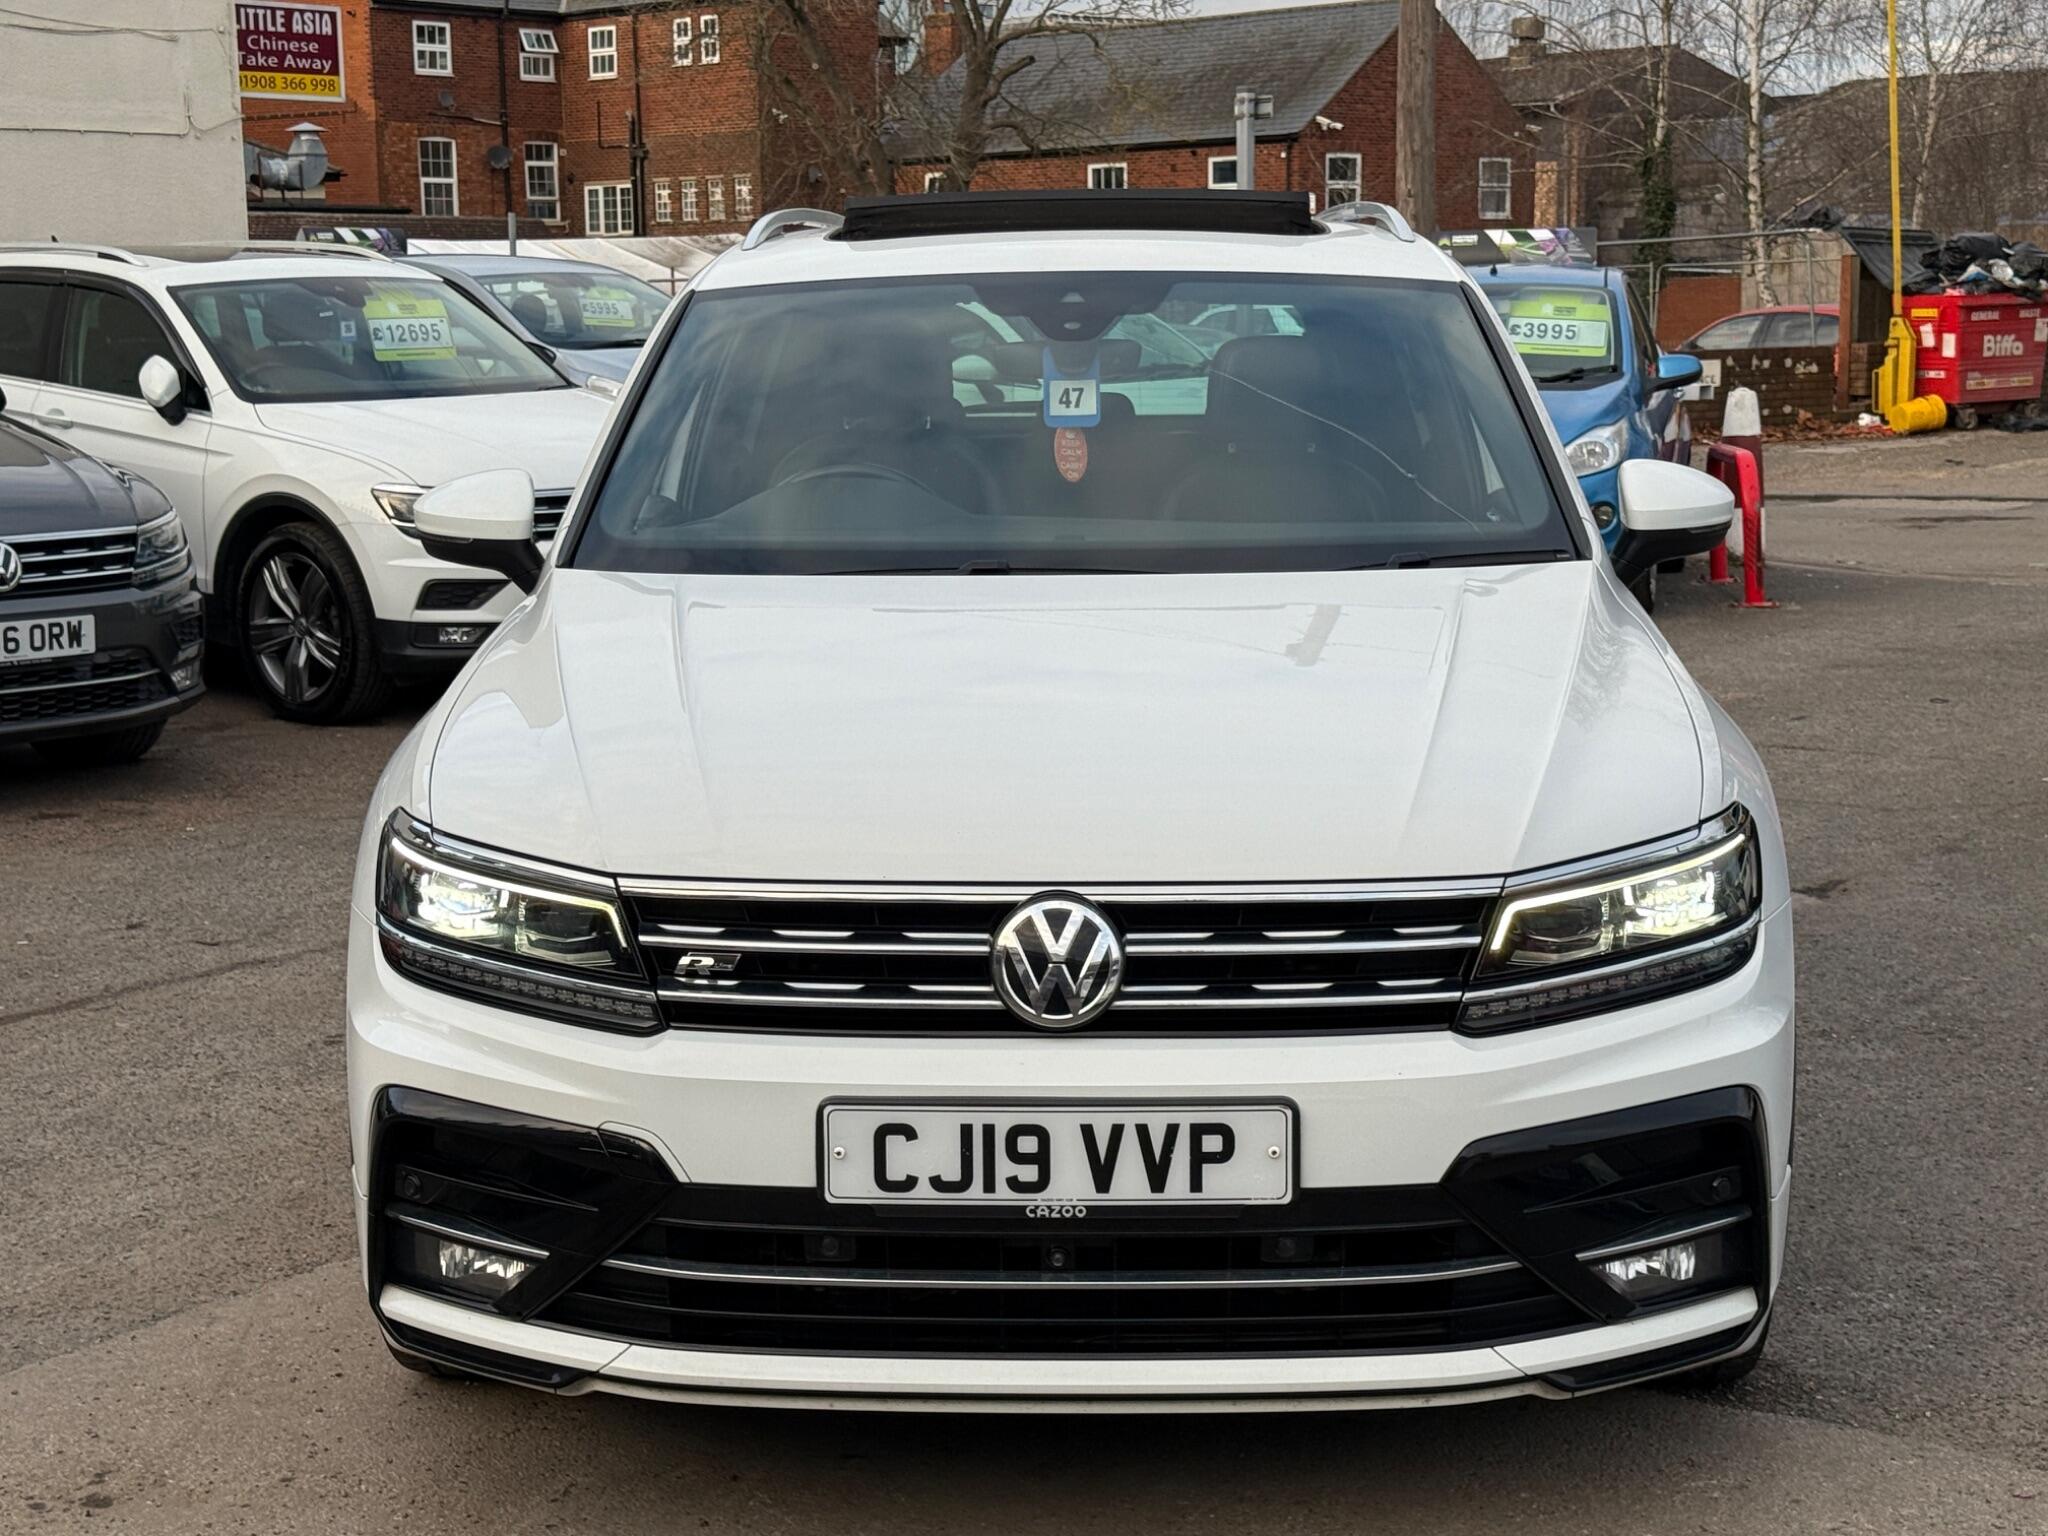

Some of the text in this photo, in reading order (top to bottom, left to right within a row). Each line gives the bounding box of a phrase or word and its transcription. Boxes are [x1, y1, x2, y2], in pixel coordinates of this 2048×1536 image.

[237, 7, 332, 36] ITTLE ASIA
[247, 35, 319, 53] Chinese
[283, 54, 332, 73] Away
[280, 77, 307, 91] 366
[310, 78, 336, 92] 998
[372, 323, 441, 342] £12695
[1509, 322, 1577, 340] £3995
[1982, 334, 2024, 357] Biffa
[1058, 387, 1085, 409] 47
[29, 620, 82, 652] ORW
[873, 1122, 1236, 1194] CJ19 VVP
[1025, 1205, 1087, 1218] CAZOO
